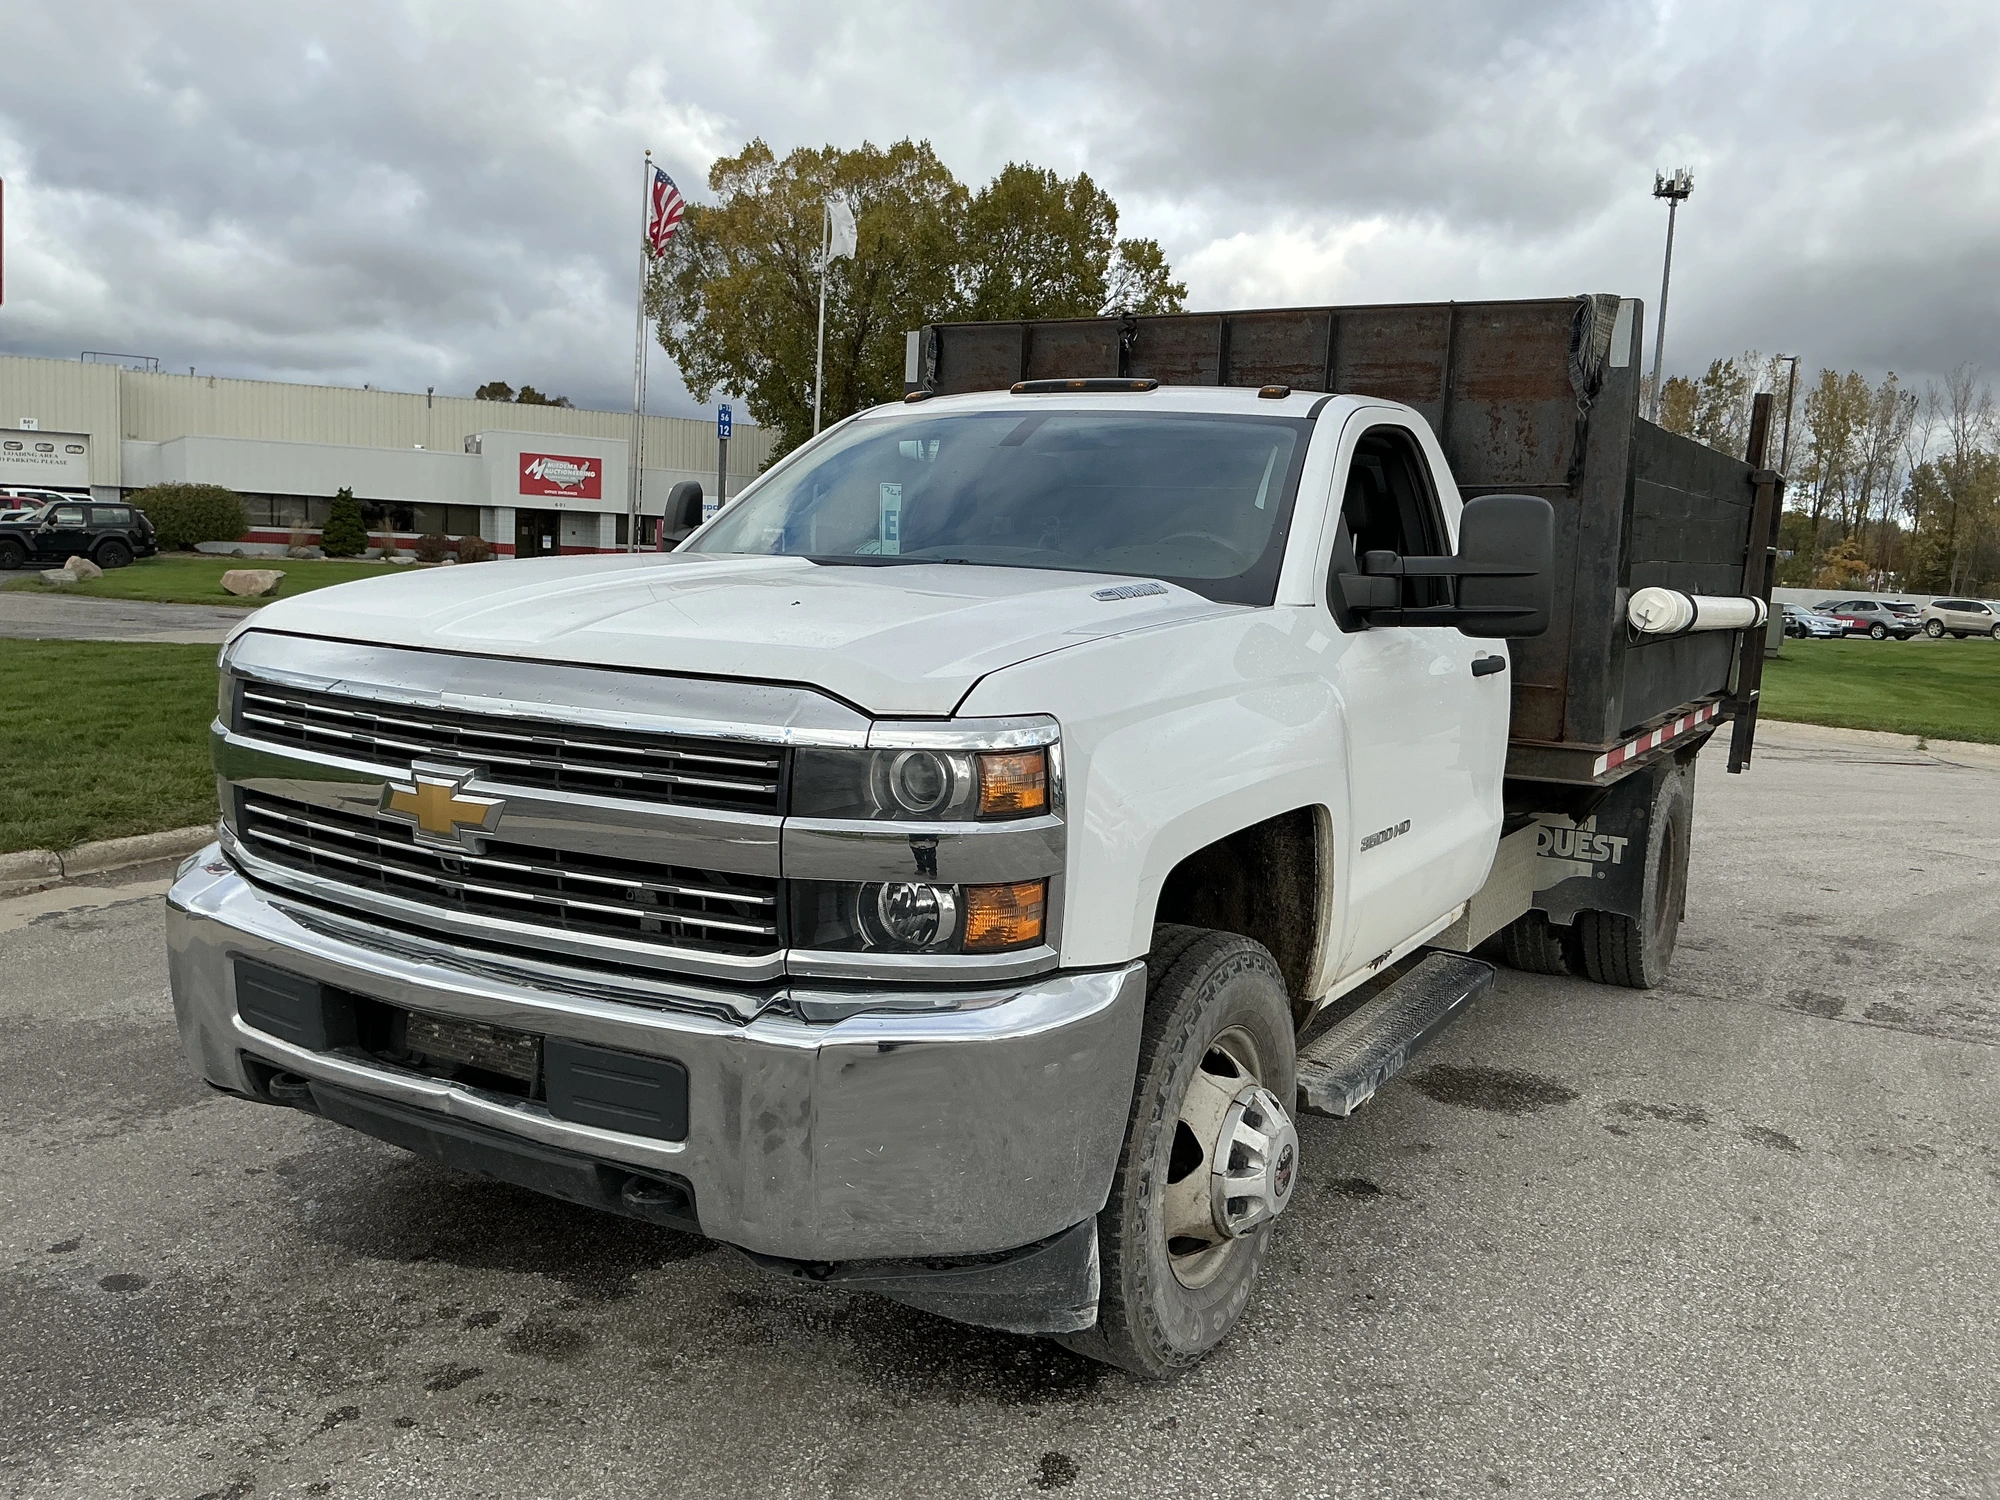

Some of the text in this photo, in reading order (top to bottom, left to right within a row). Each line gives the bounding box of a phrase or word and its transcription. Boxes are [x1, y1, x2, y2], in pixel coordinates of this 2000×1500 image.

[720, 413, 729, 421] 56
[719, 424, 730, 435] 12
[547, 462, 578, 470] MIEDEMA
[545, 468, 596, 478] AUCTIONEERING
